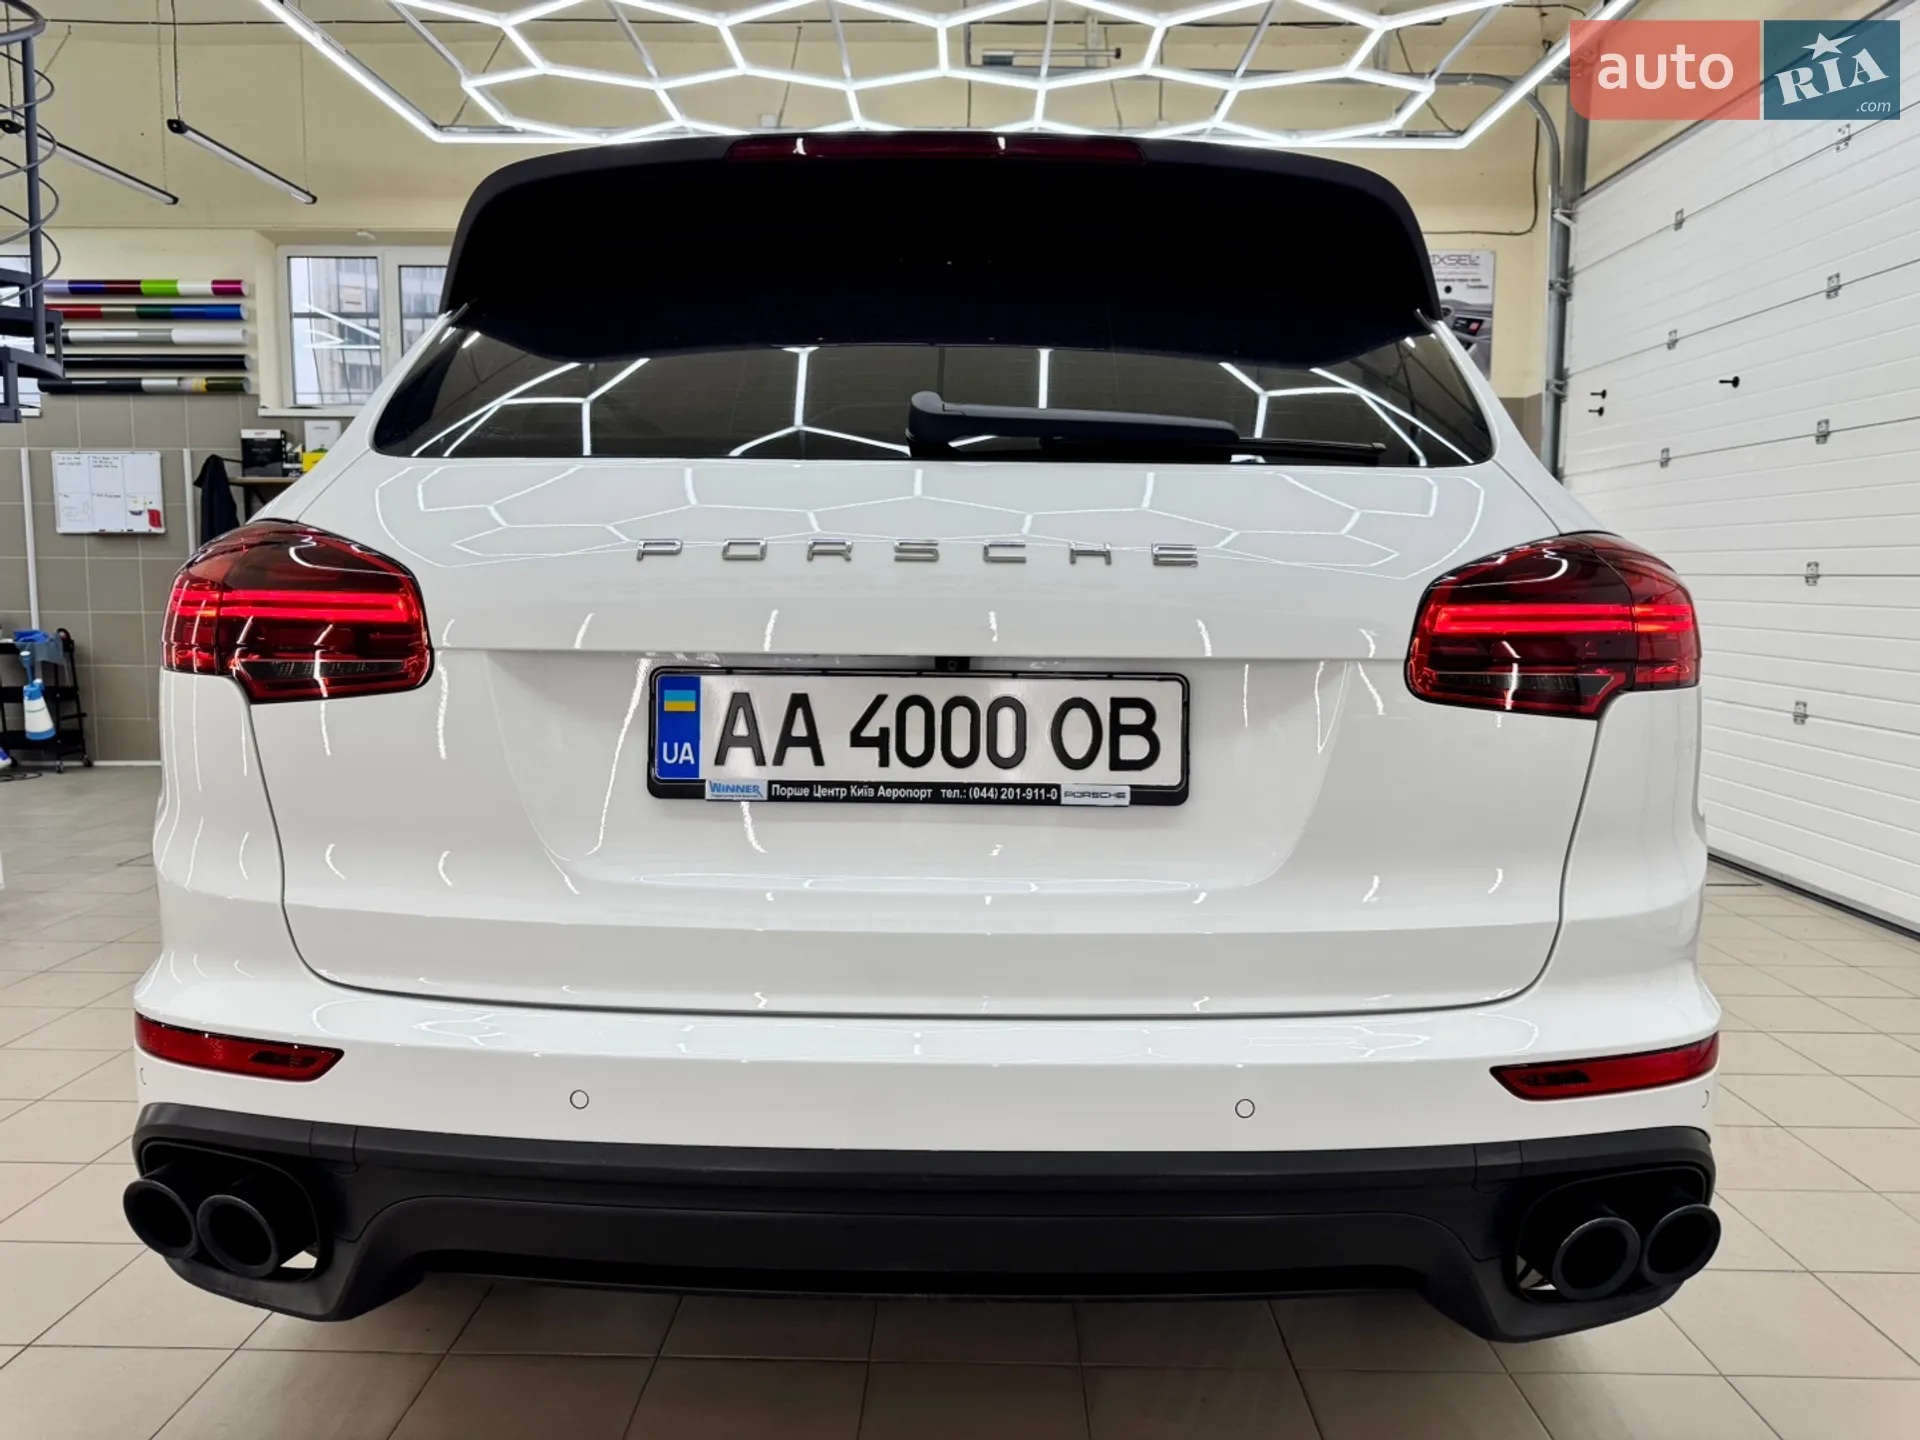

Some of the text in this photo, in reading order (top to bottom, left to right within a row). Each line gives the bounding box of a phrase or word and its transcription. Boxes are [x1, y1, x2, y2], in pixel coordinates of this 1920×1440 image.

[636, 538, 1199, 567] PORSCHE
[714, 692, 1161, 771] AA 4000 OB
[662, 742, 695, 765] UA
[771, 784, 1058, 800] Порше Центр Київ Аеропорт тел.: (044) 201-911-0
[1064, 790, 1126, 799] PORSCHE
